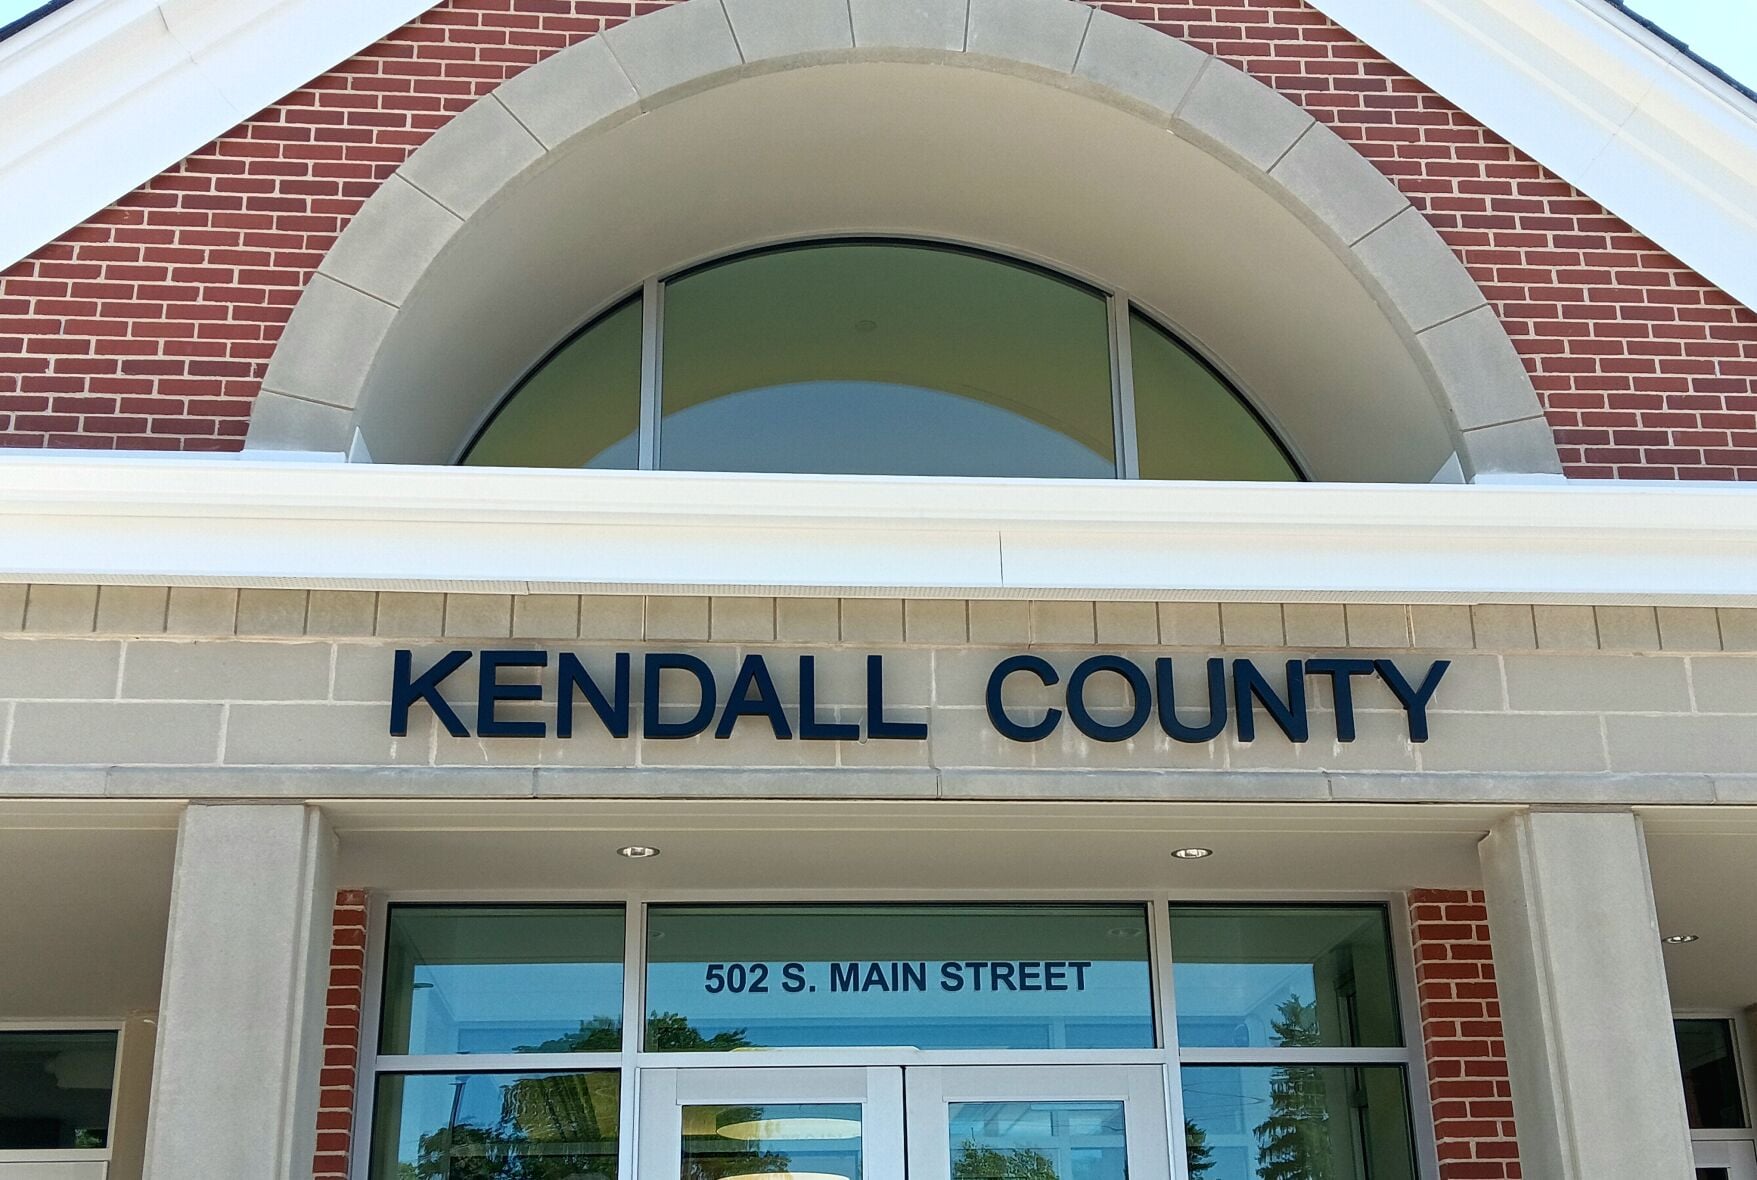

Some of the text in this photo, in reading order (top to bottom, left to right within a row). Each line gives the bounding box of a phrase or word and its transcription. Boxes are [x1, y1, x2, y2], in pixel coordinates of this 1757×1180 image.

[390, 650, 1451, 743] KENDALL COUNTY
[704, 961, 1092, 994] 502 S. MAIN STREET
